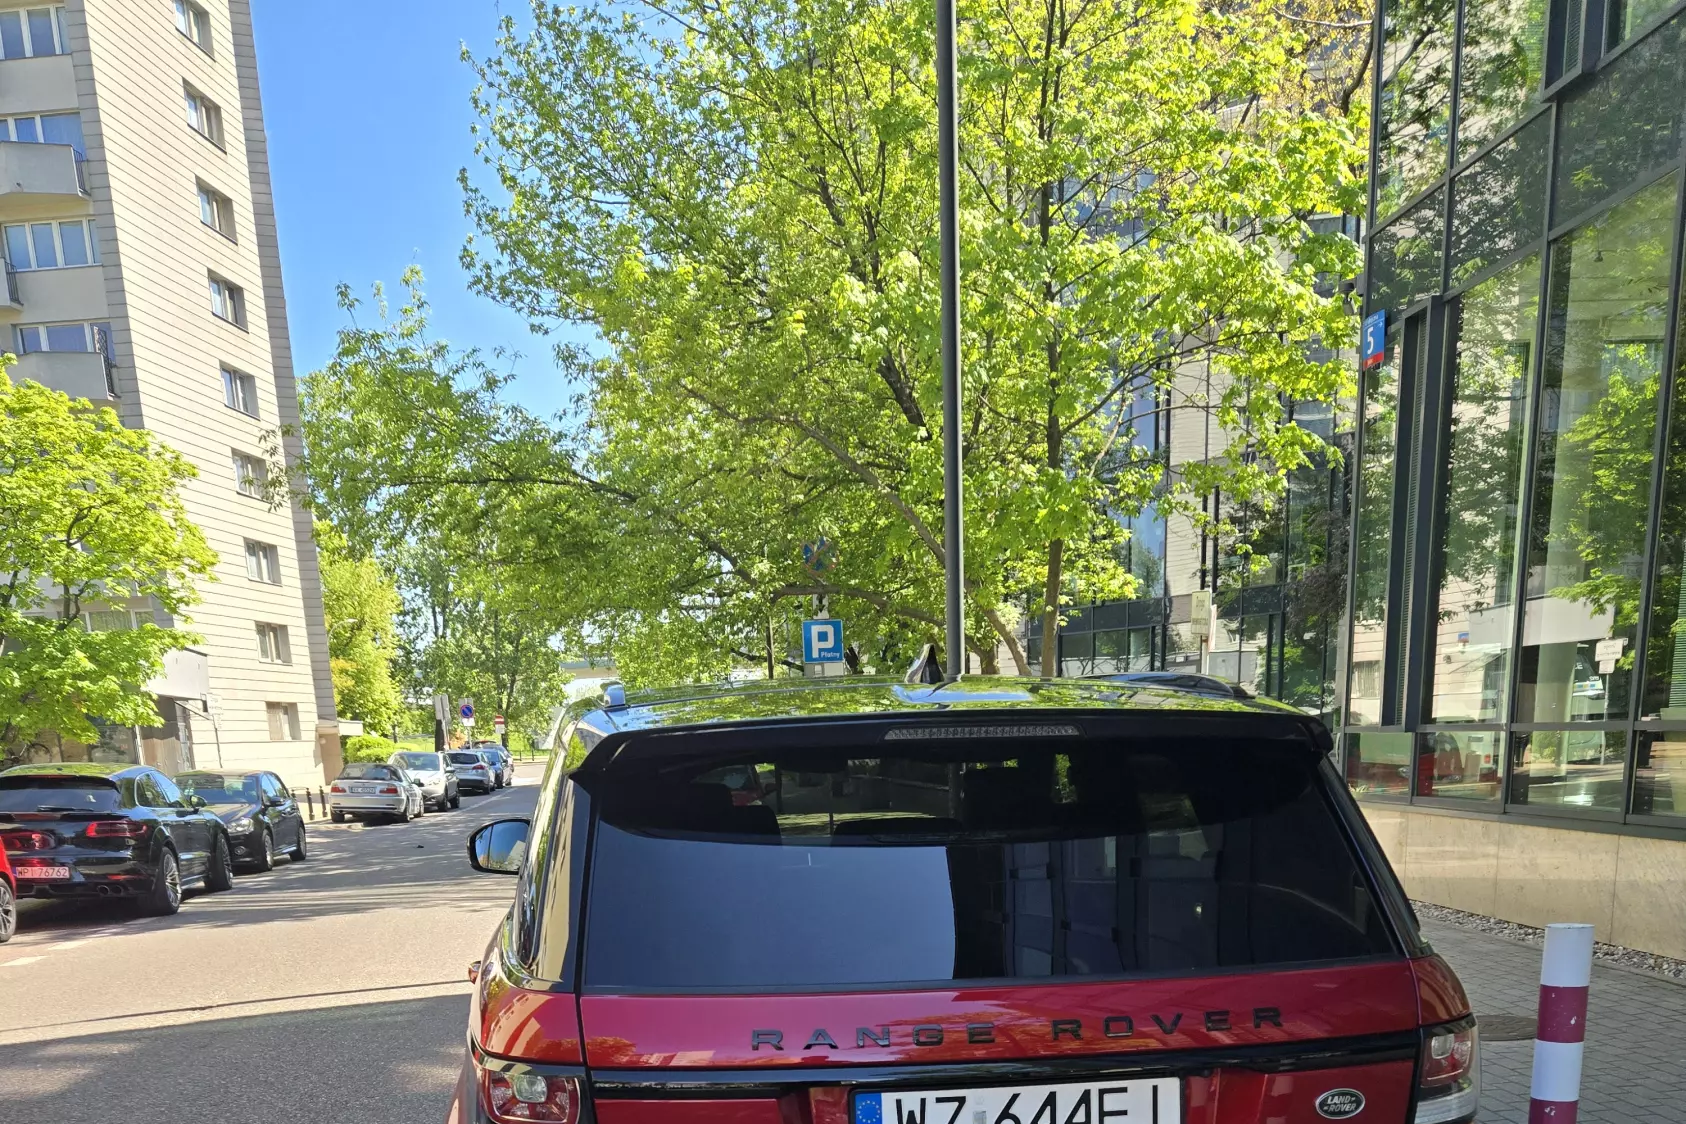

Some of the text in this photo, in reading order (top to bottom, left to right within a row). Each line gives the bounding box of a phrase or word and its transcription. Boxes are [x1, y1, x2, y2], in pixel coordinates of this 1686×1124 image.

[1367, 327, 1374, 354] 5
[811, 624, 834, 658] P
[38, 867, 68, 878] 76762
[751, 1006, 1284, 1051] RANGE ROVER
[1328, 1103, 1357, 1112] ROVER
